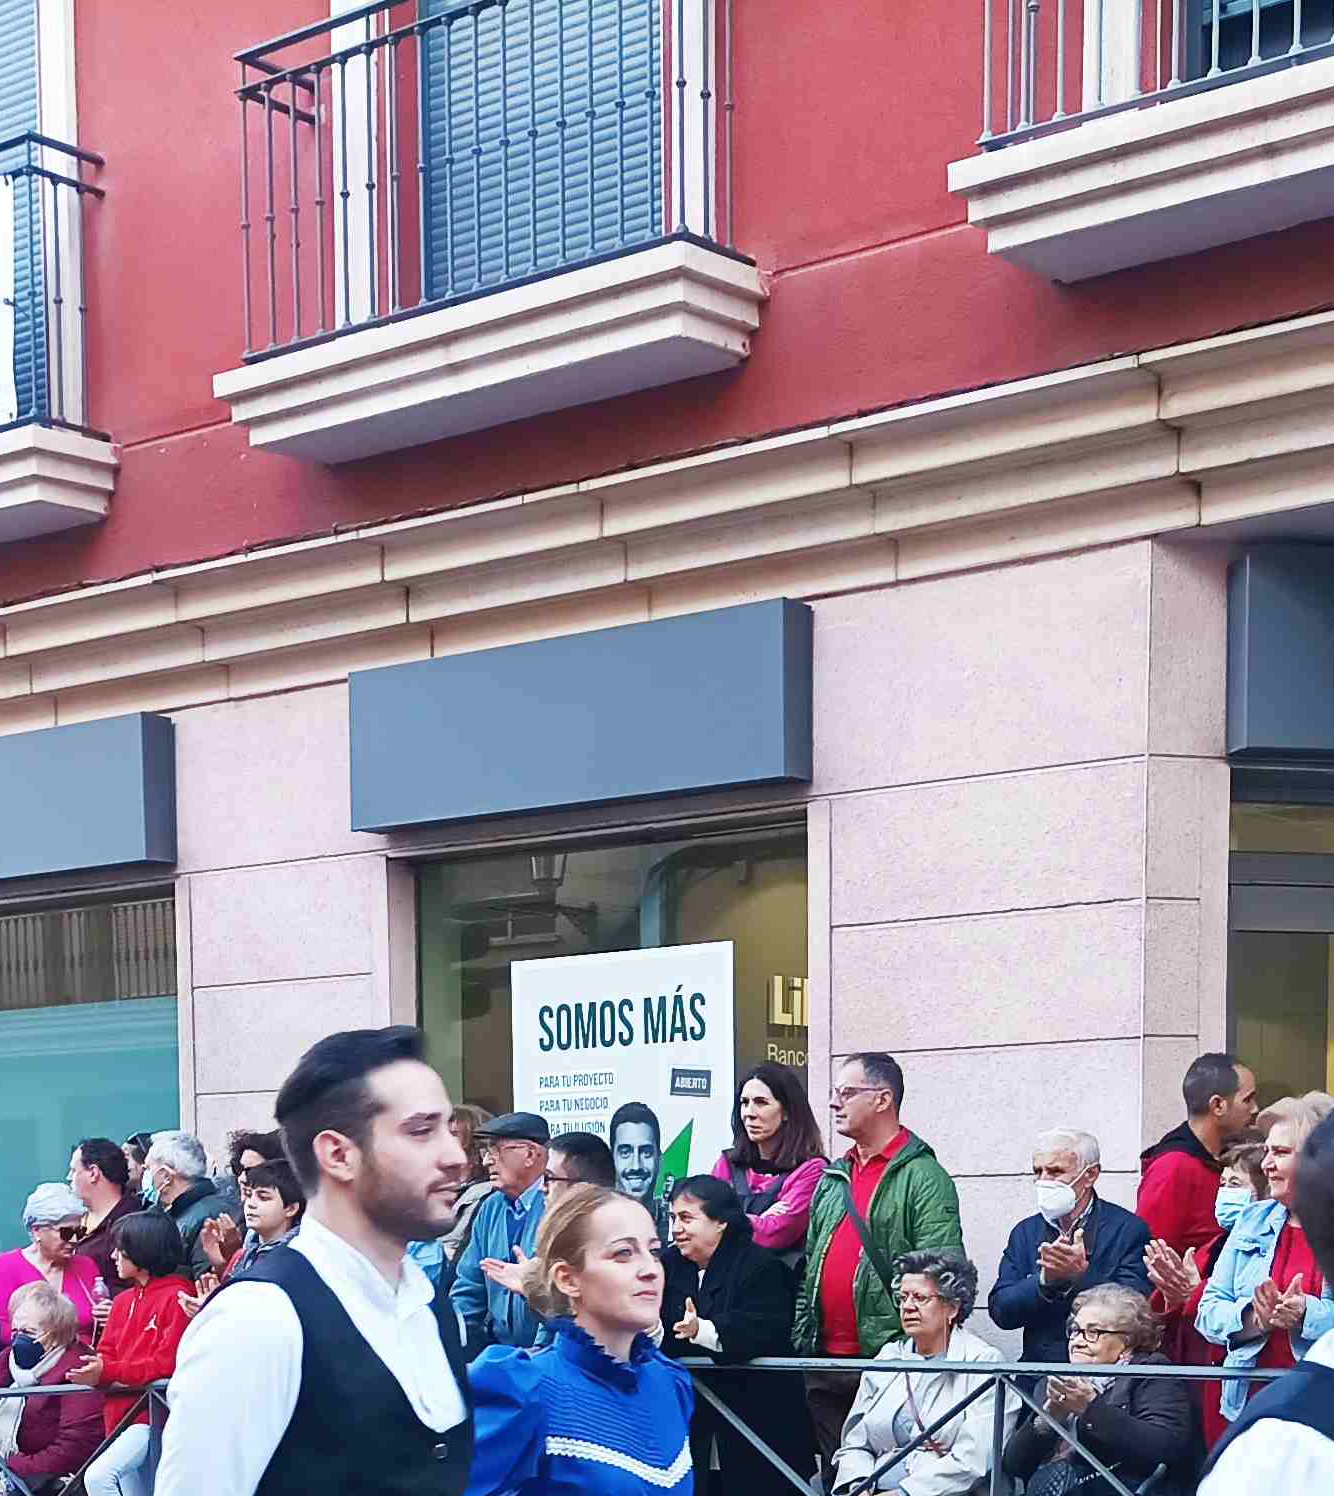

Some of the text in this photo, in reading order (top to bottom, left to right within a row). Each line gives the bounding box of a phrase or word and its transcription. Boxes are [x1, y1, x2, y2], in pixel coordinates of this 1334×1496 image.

[539, 984, 707, 1052] SOMOS MÁS
[539, 1075, 560, 1089] PARA
[561, 1075, 572, 1088] TU
[675, 1076, 708, 1090] ABIERTO
[539, 1099, 561, 1112] PARA
[562, 1099, 573, 1112] TU
